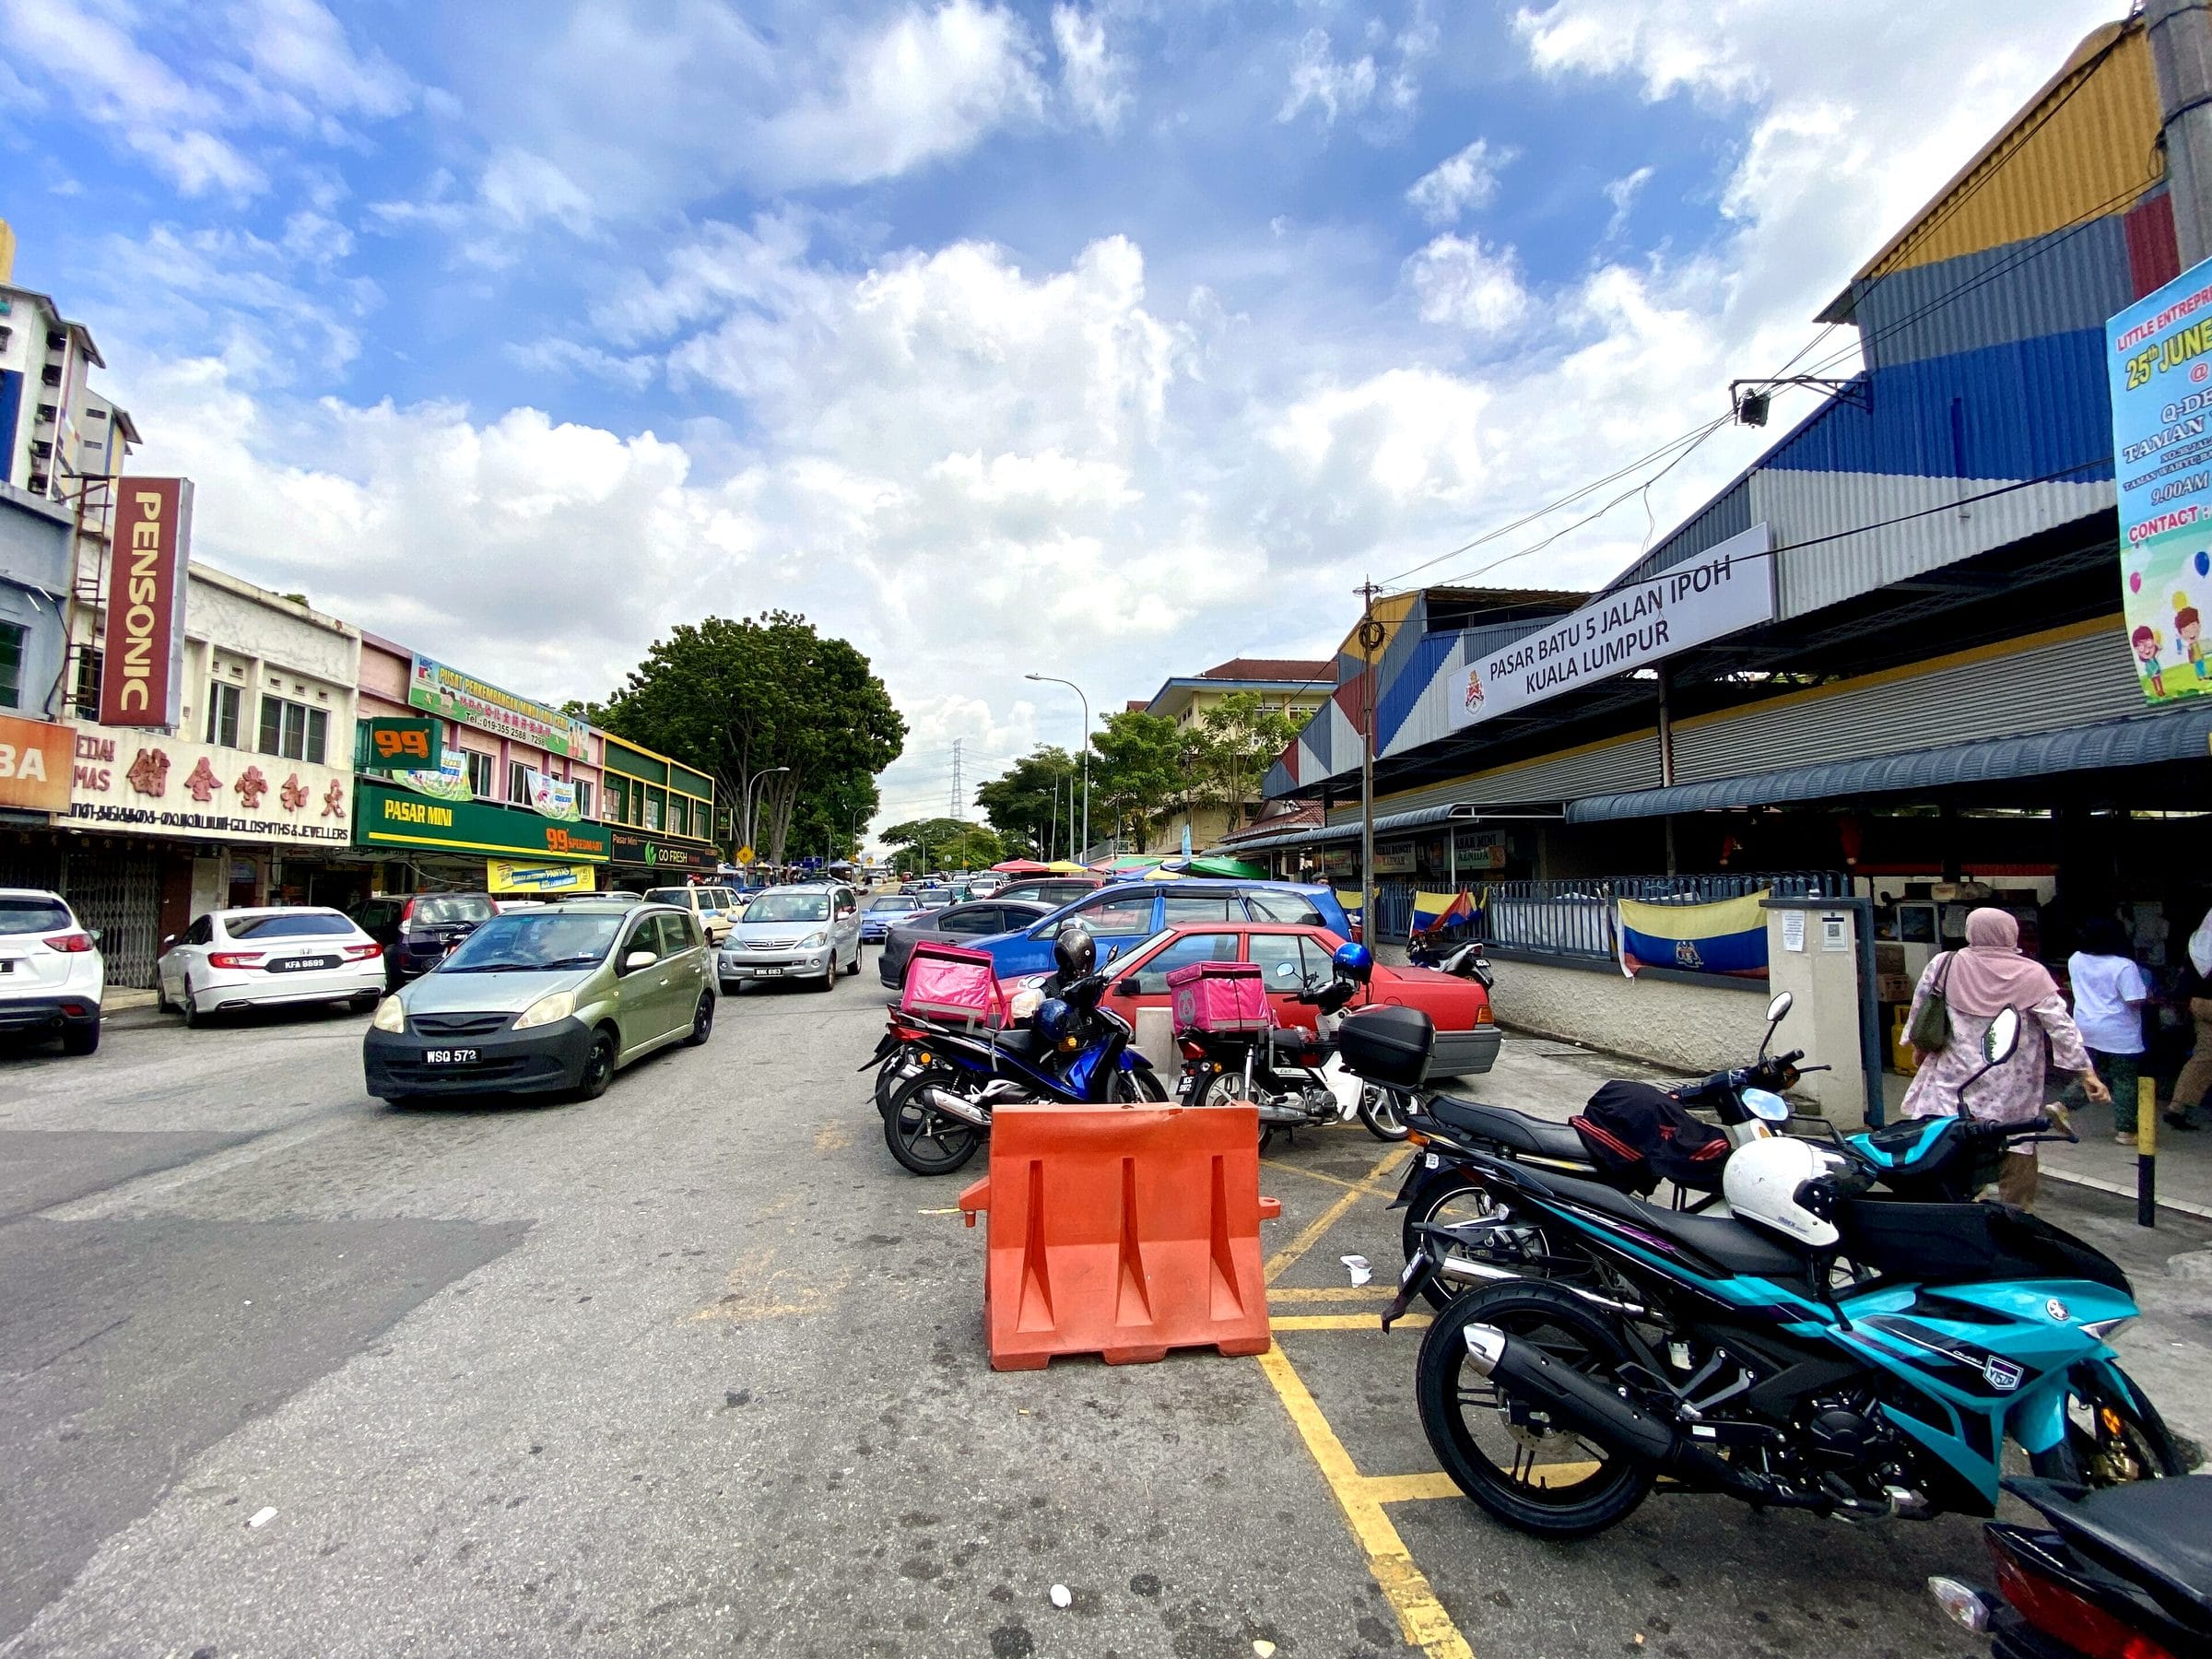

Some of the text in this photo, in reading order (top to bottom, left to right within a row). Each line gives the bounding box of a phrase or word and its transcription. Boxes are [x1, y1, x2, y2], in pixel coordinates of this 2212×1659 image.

[2117, 285, 2212, 352] LITTLE ENTREPR
[2125, 316, 2212, 392] 25th JUNE
[2123, 416, 2205, 464] TAMAN
[2151, 471, 2209, 506] 9.00AM
[2129, 506, 2198, 544] CONTACT
[121, 492, 162, 711] PENSONIC
[1490, 554, 1731, 681] PASAR BATU 5 JALAN IPOH
[1526, 620, 1670, 694] KUALA LUMPUR
[439, 665, 463, 691] PUSAT
[465, 677, 518, 713] PERKEMBANGAN
[374, 729, 429, 759] 99
[511, 728, 526, 741] 2588
[73, 765, 111, 791] MAS
[384, 799, 453, 827] PASAR MINI
[230, 818, 348, 840] GOLDSMITHS & JEWELLERS
[547, 828, 569, 853] 99
[612, 834, 638, 845] Pasar Mini
[1477, 833, 1497, 847] MINI
[659, 849, 668, 862] GO
[670, 850, 688, 863] FRESH
[427, 1051, 451, 1063] WSQ
